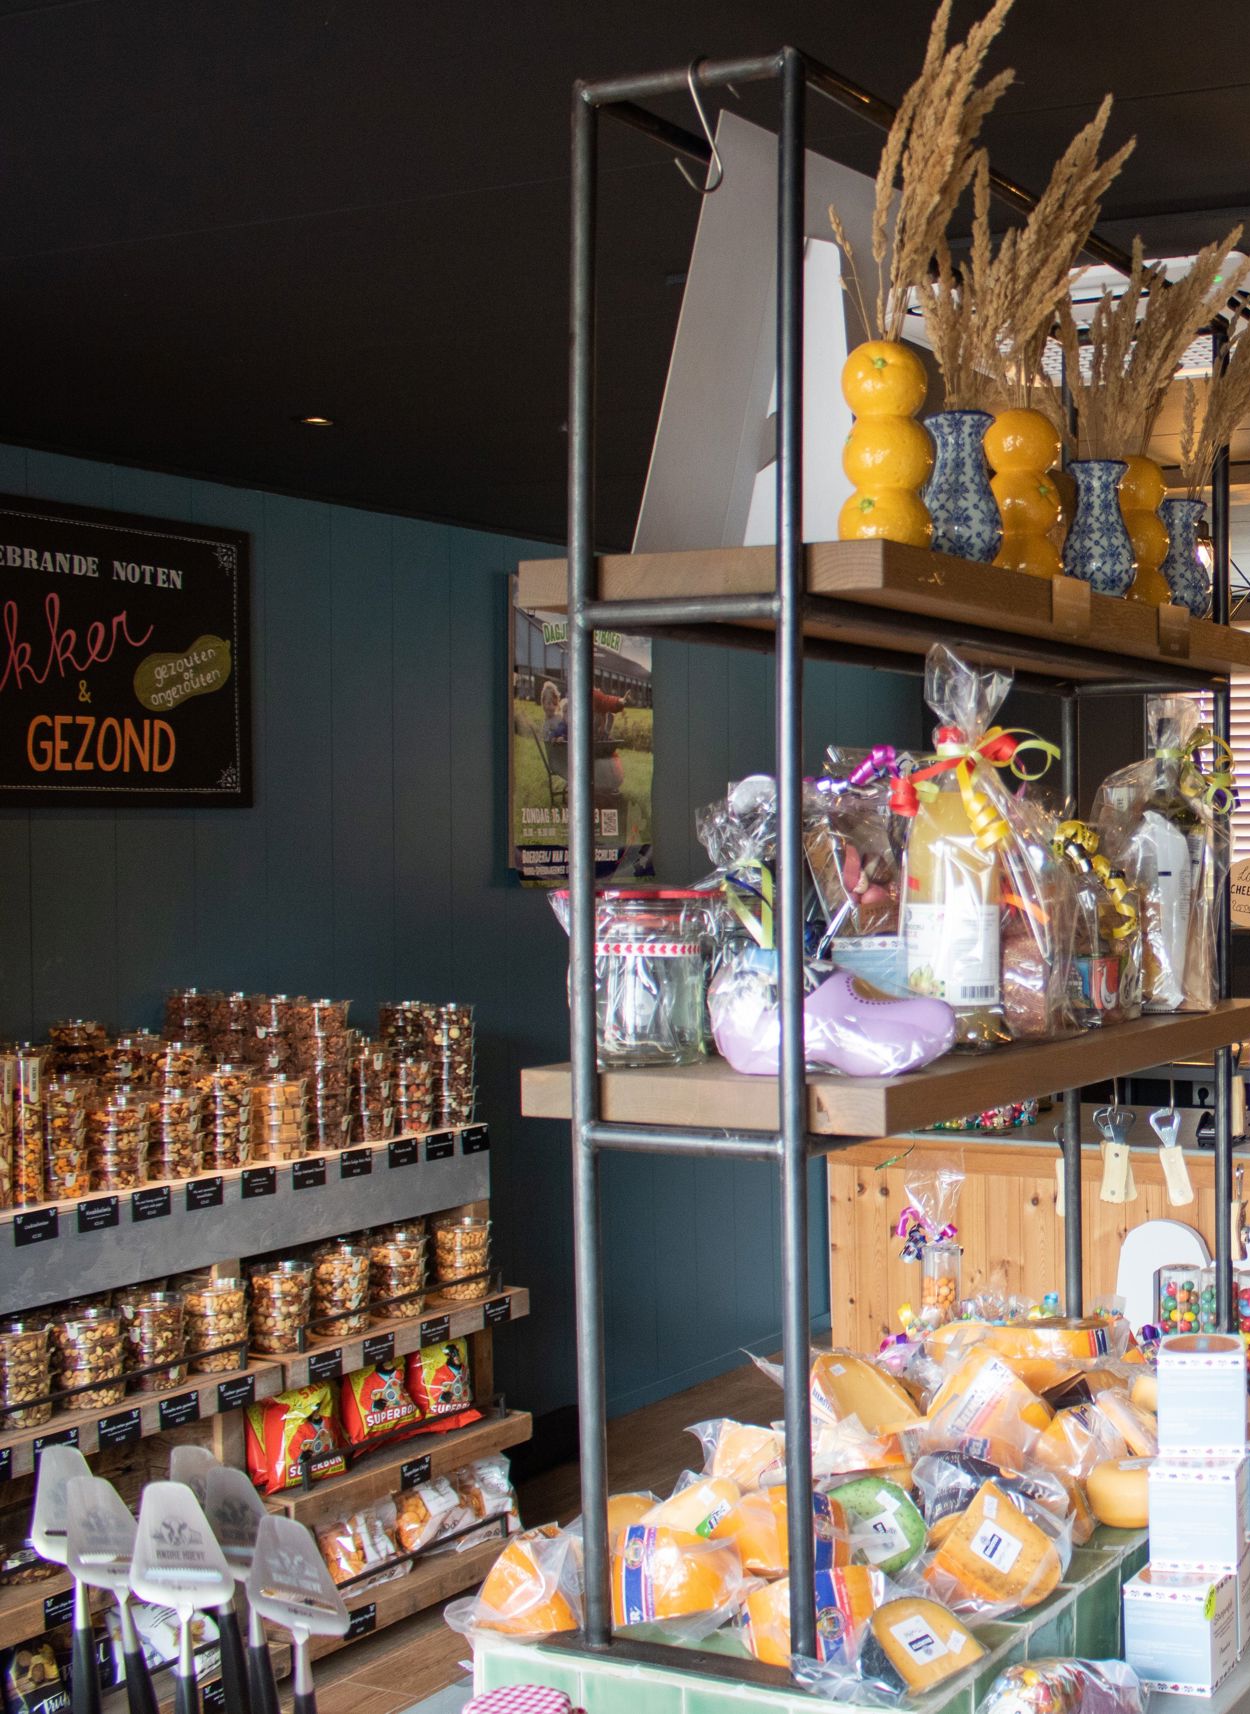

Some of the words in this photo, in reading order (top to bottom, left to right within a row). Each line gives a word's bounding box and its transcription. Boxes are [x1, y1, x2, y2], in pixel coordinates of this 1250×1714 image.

[112, 560, 183, 590] NOTEN
[154, 647, 216, 687] gezouten
[183, 667, 194, 681] of
[151, 668, 221, 707] ongezouten
[27, 714, 176, 773] GEZOND
[522, 808, 550, 823] ZONDAG
[289, 1456, 342, 1477] SUERBON
